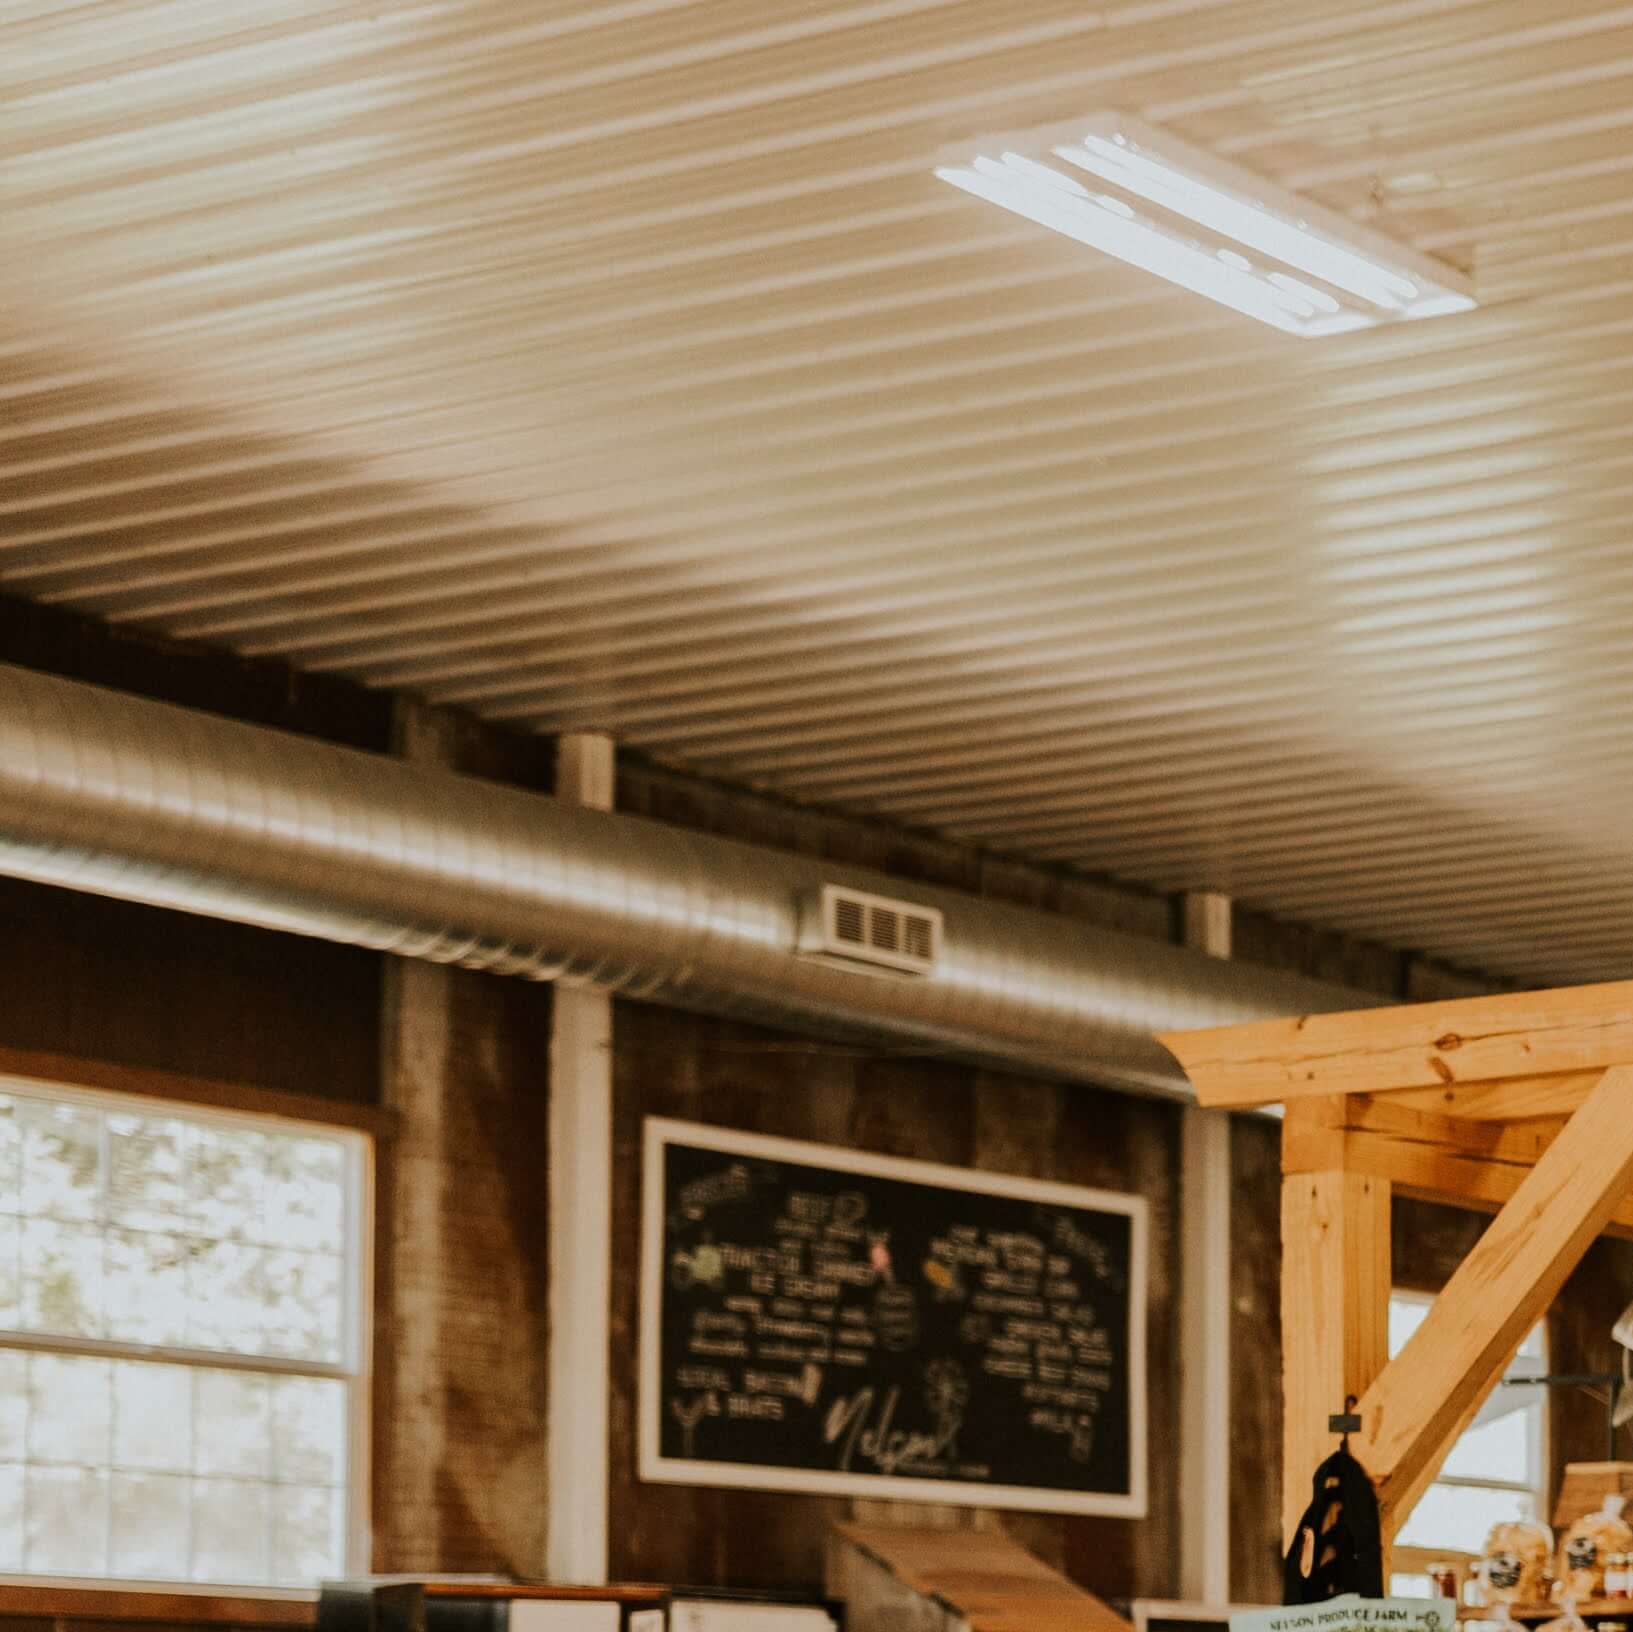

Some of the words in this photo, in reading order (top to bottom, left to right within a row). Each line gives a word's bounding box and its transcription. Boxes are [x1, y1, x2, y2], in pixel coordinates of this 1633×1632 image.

[1270, 1614, 1314, 1631] NELSON
[1317, 1609, 1368, 1625] PRODUCE
[1375, 1608, 1408, 1621] FARM
